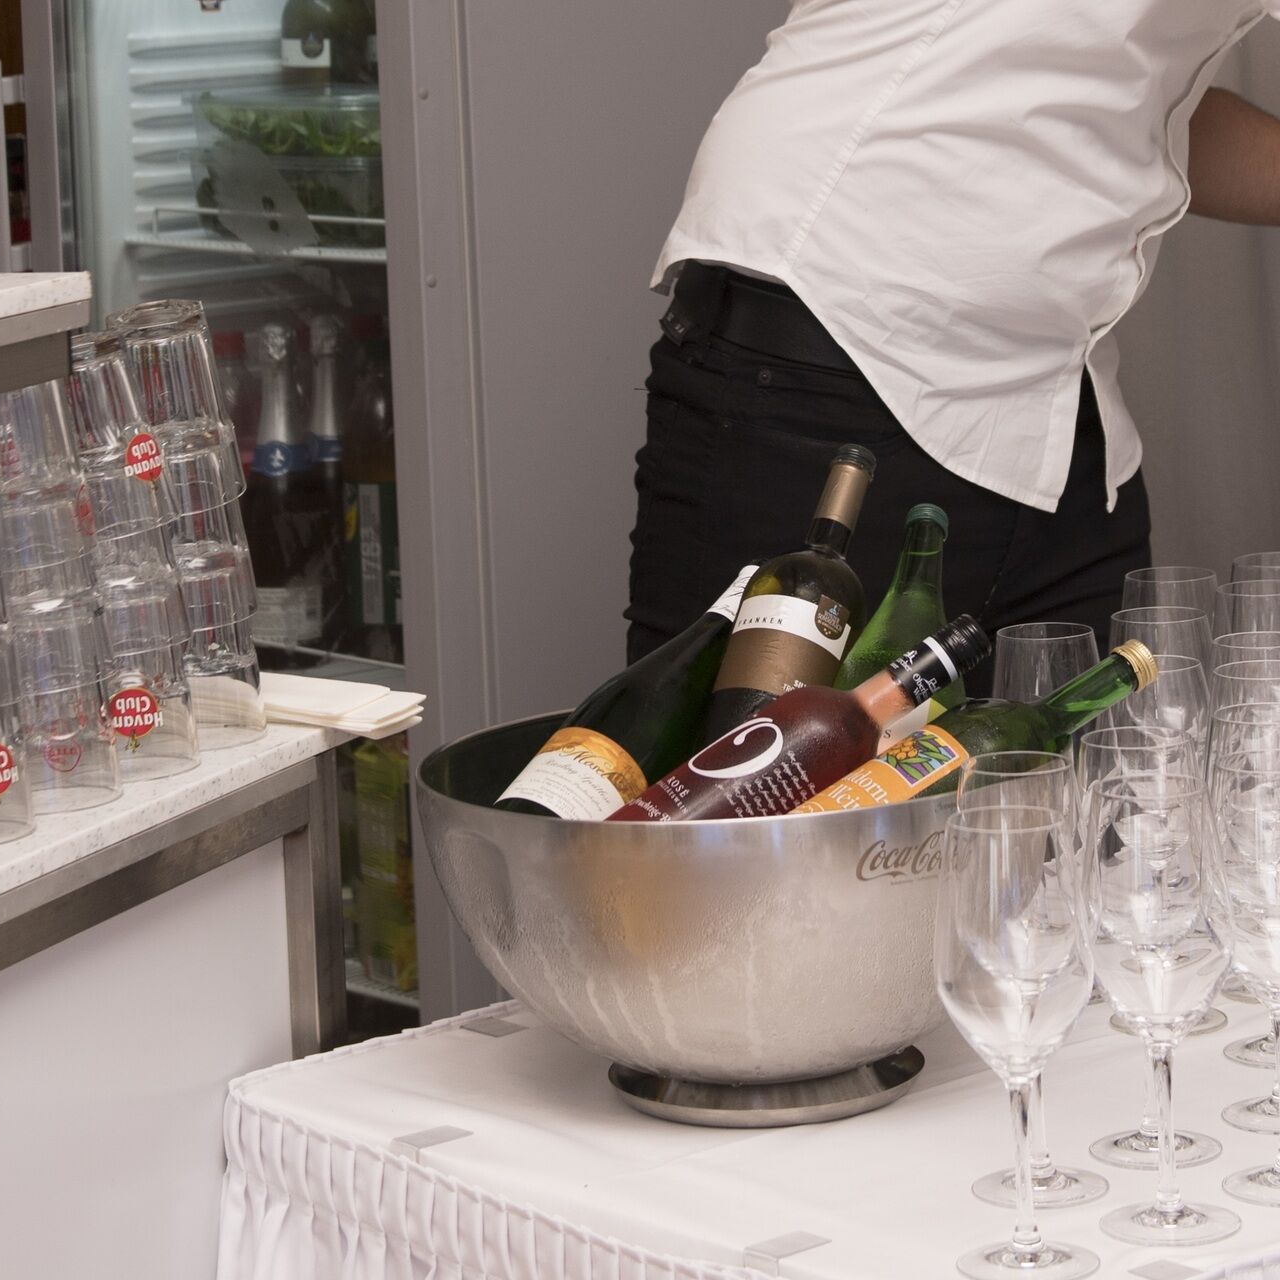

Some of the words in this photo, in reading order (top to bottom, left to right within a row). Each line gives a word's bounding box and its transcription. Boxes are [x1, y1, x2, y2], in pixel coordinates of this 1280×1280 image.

[131, 439, 157, 460] Club
[124, 455, 161, 477] avana
[737, 616, 783, 627] FRANKEN
[115, 696, 151, 714] Club
[111, 711, 164, 728] Havan
[667, 775, 691, 798] ROSÉ
[856, 830, 973, 882] Coca-Co
